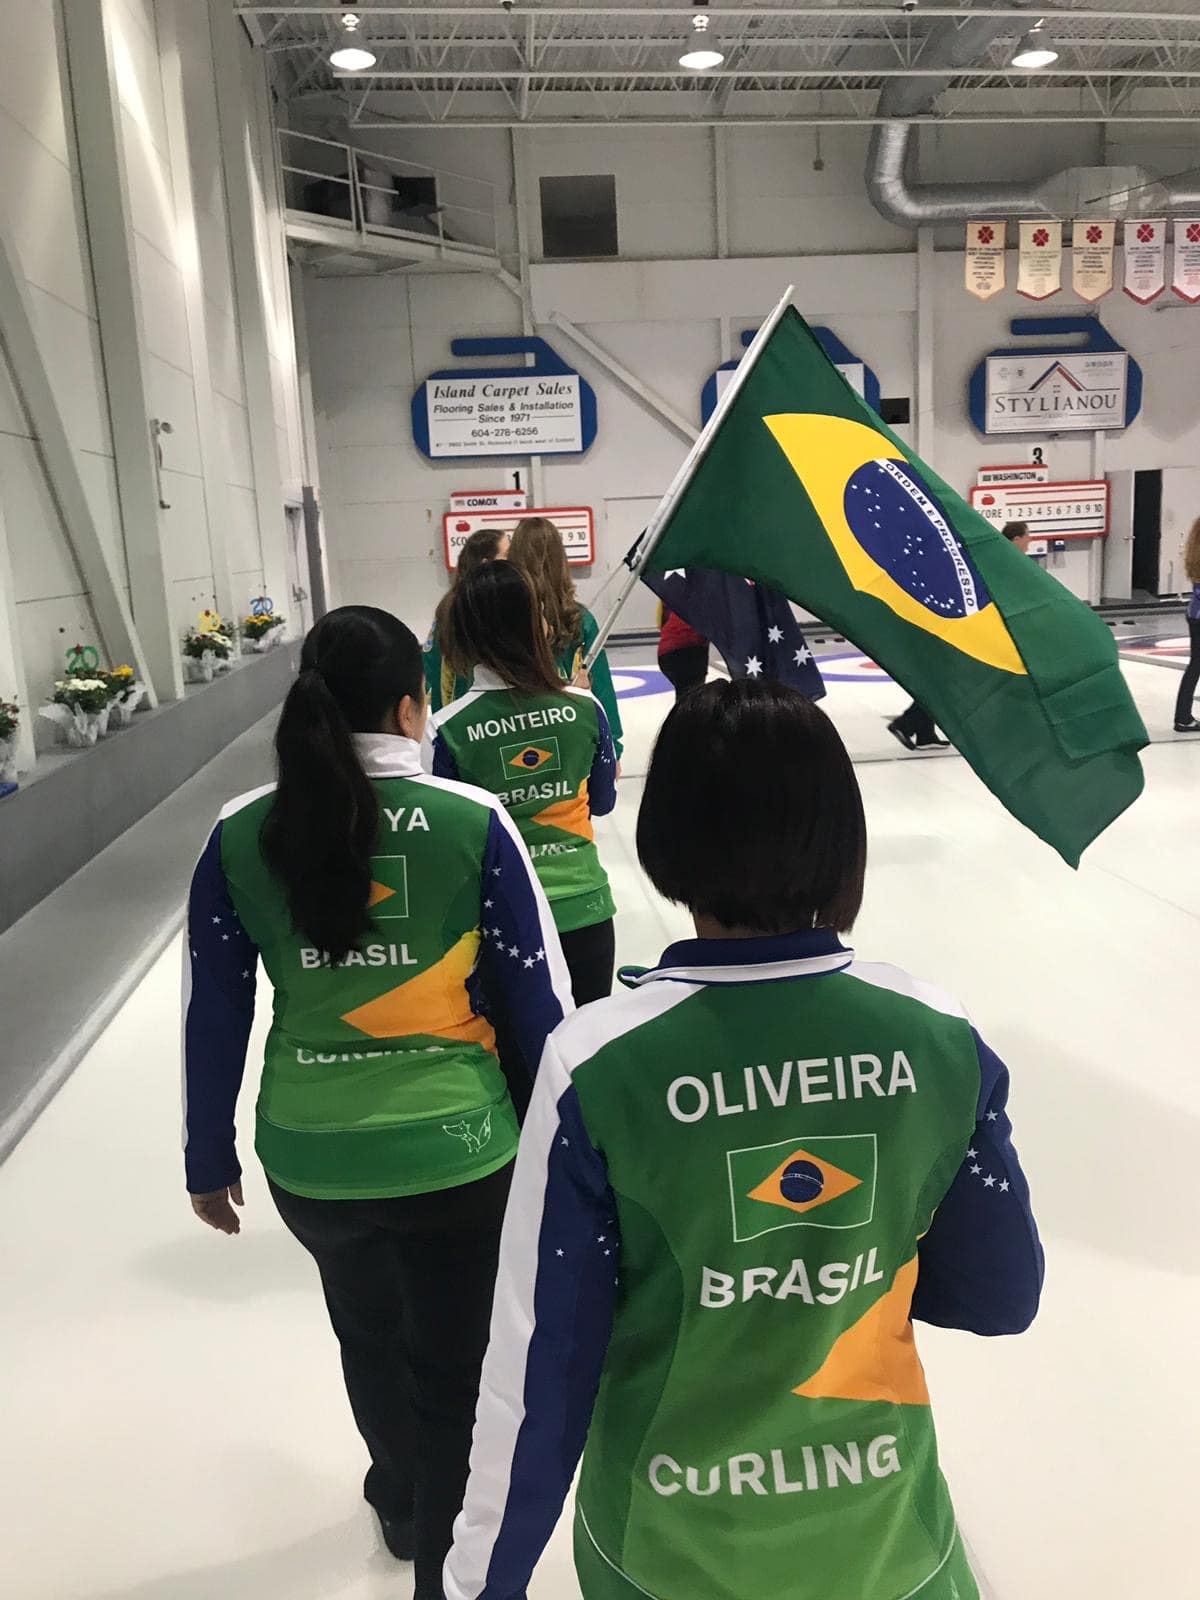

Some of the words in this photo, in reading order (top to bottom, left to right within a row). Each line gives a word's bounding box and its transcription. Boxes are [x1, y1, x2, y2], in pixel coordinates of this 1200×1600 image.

[434, 385, 476, 399] Island
[482, 384, 530, 399] Carpet
[536, 382, 573, 396] Sales
[433, 404, 474, 414] Flooring
[477, 403, 505, 412] Sales
[509, 402, 516, 411] &
[520, 401, 574, 411] Installation
[994, 394, 1117, 413] STYLIANOU
[478, 414, 506, 423] Since
[510, 413, 531, 422] 1971
[471, 427, 539, 438] 604-278-6256
[1032, 447, 1043, 464] 3
[512, 471, 521, 490] 1
[992, 472, 1037, 481] WASHINGTON
[467, 498, 498, 507] COMOX
[1008, 508, 1012, 517] 1
[1018, 508, 1023, 517] 2
[1027, 507, 1033, 517] 3
[1036, 507, 1042, 516] 4
[1046, 506, 1052, 515] 5
[1056, 506, 1061, 515] 6
[1066, 505, 1071, 514] 7
[1075, 505, 1081, 514] 8
[1085, 504, 1091, 513] 9
[1094, 504, 1102, 513] 10
[568, 531, 574, 541] 9
[576, 531, 586, 541] 10
[885, 463, 927, 507] ORDEM
[926, 509, 935, 517] E
[934, 519, 975, 607] PROGRESSO
[65, 645, 100, 674] 20
[466, 706, 577, 742] MONTEIRO
[497, 780, 573, 806] BRASIL
[666, 1050, 917, 1123] OLIVEIRA
[700, 1247, 884, 1309] BRASIL
[648, 1434, 901, 1497] CURLING
